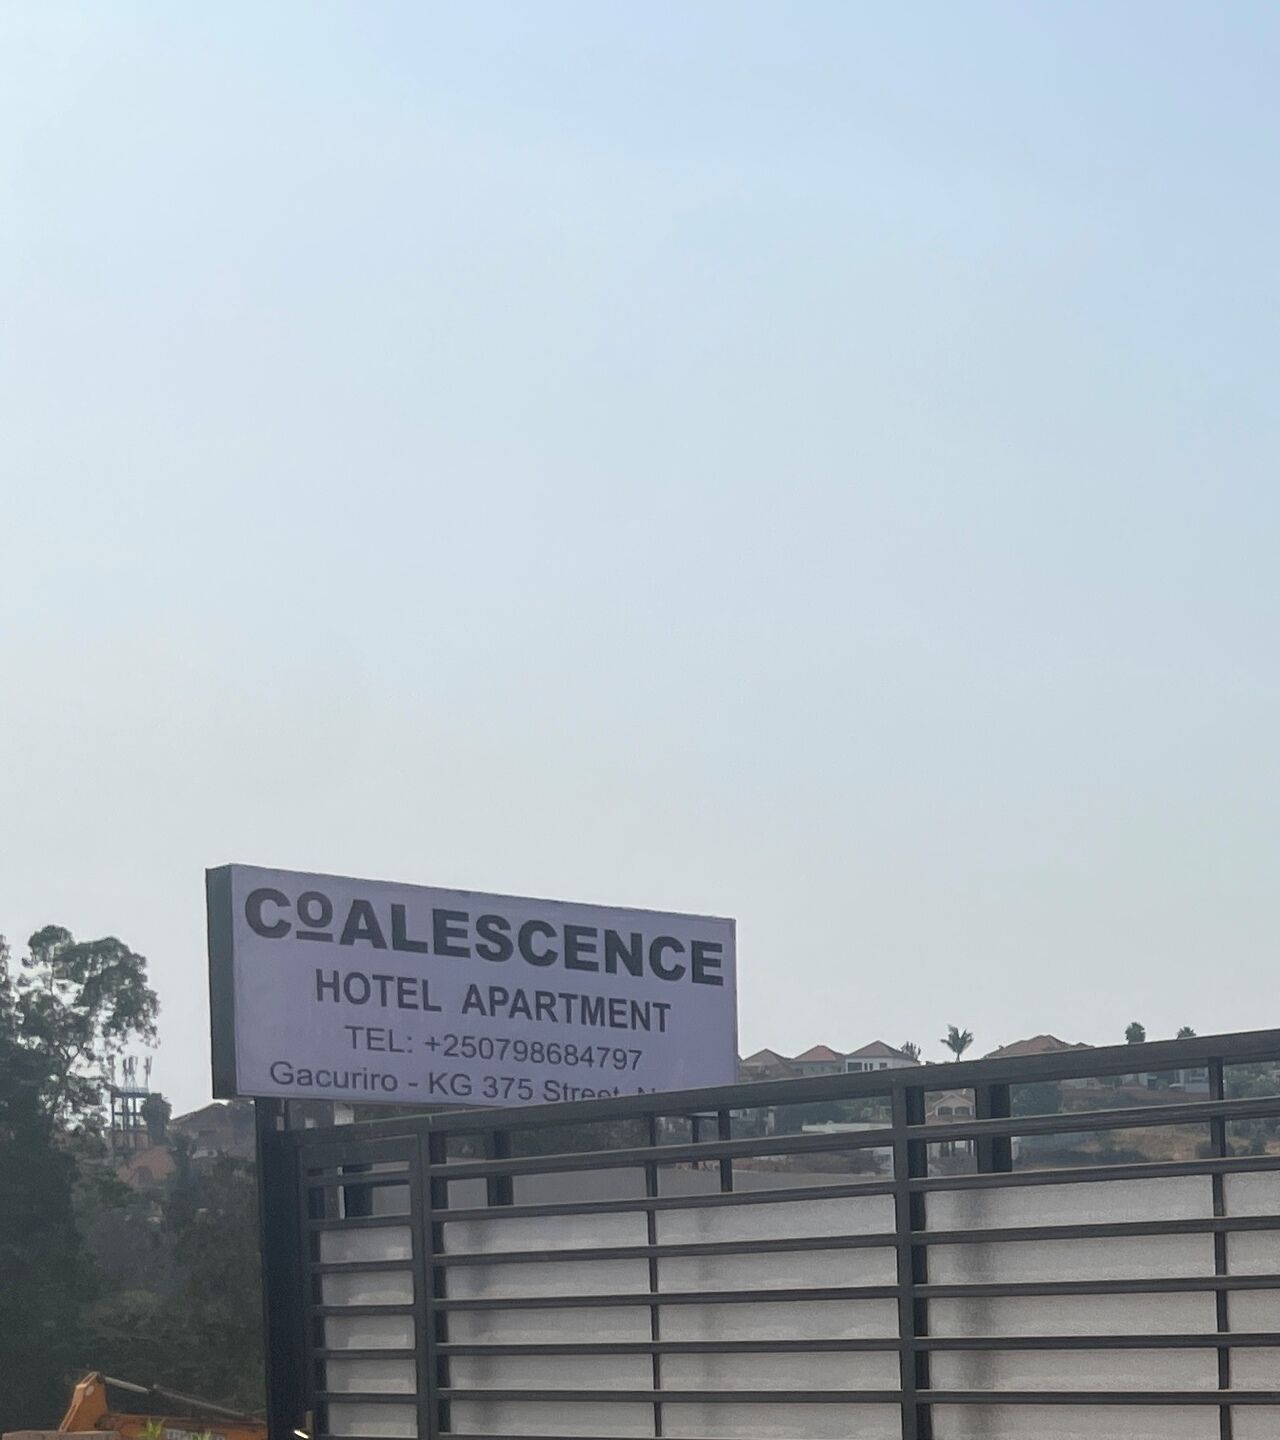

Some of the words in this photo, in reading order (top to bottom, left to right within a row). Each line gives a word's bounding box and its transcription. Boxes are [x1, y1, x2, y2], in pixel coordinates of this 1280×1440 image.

[315, 968, 442, 1012] HOTEL
[461, 983, 671, 1033] APARTMENT
[344, 1025, 413, 1053] TEL:
[424, 1033, 643, 1071] +250798684797
[270, 1061, 398, 1092] Gacuriro
[428, 1072, 472, 1096] KG
[483, 1076, 533, 1100] 375
